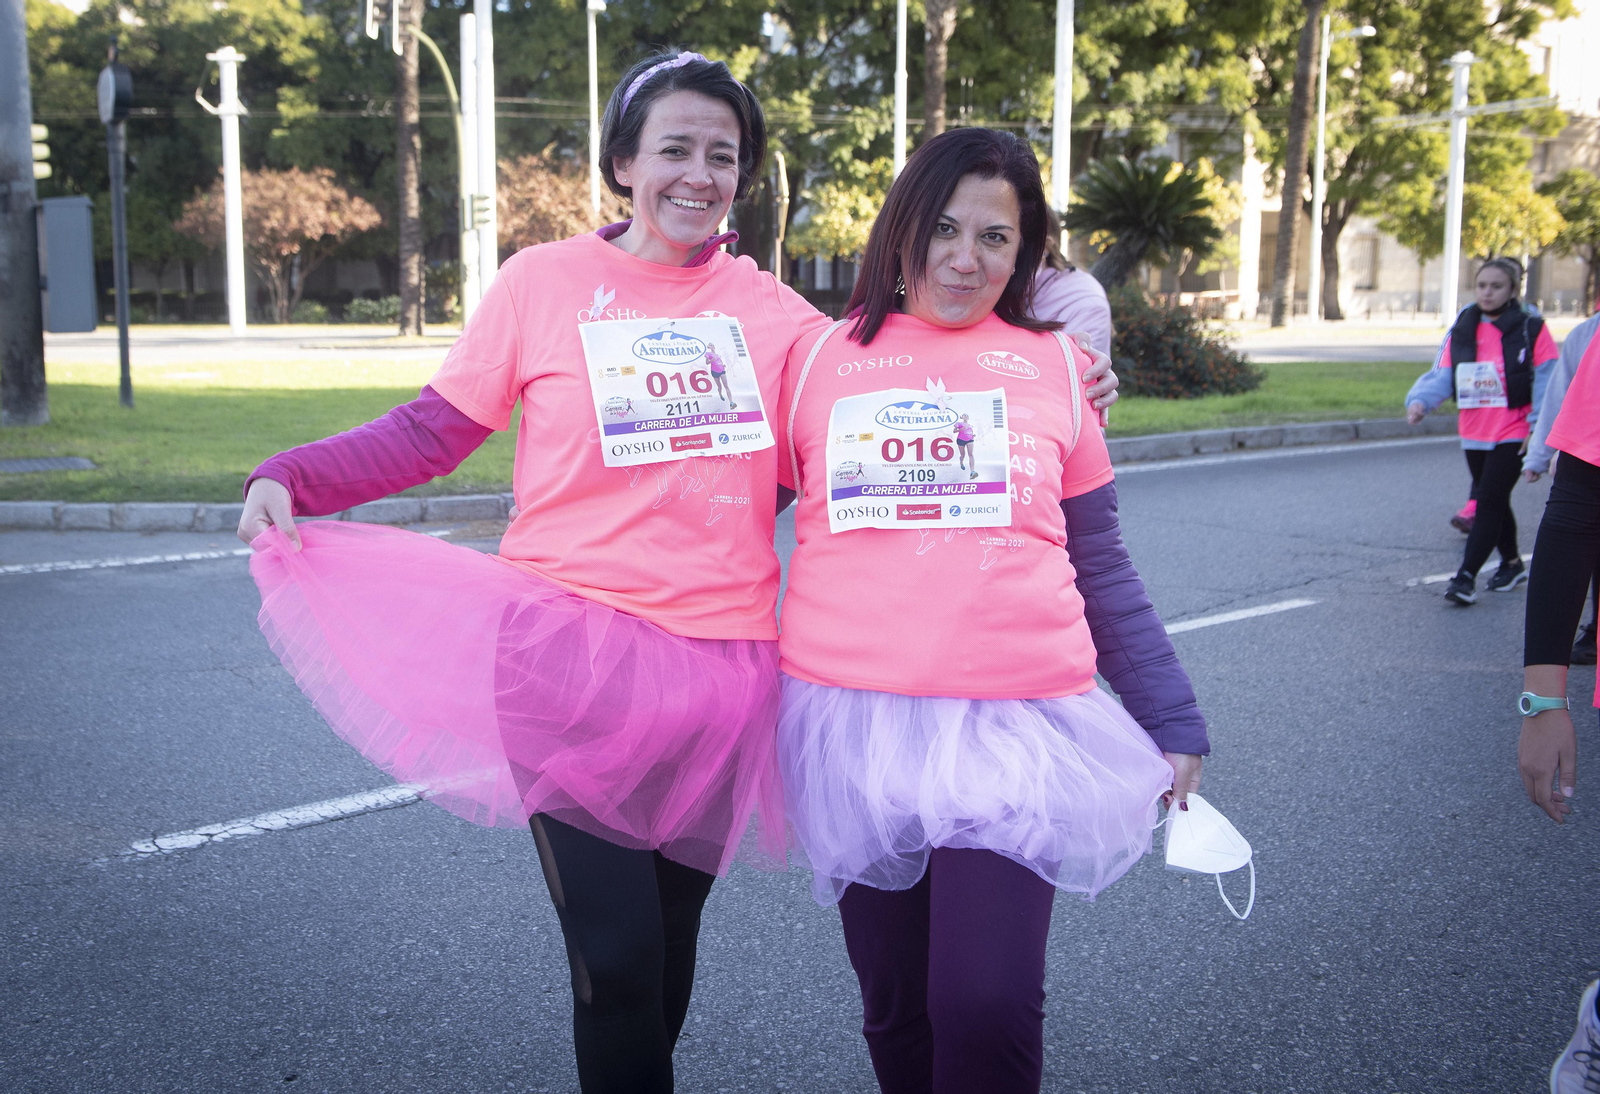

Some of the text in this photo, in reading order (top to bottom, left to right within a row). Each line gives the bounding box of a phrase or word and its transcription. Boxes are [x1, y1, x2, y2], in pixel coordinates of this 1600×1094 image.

[577, 308, 647, 323] OSHO
[639, 343, 702, 356] ASTURIANA
[837, 355, 913, 376] OYSHO
[982, 355, 1036, 377] ASTURIANA
[646, 370, 713, 398] 016
[665, 400, 700, 416] 2111
[635, 413, 738, 431] CARRERA DE LA MUJER
[881, 410, 952, 424] ASTURIANA
[681, 438, 707, 446] Santander
[732, 432, 761, 442] ZURICH
[611, 440, 665, 457] OYSHO
[881, 437, 954, 463] 016
[898, 469, 936, 483] 2109
[861, 484, 977, 496] CARRERA DE LA MUJER
[734, 496, 750, 505] 2021
[837, 505, 889, 521] OYSHO
[965, 506, 998, 514] ZURICH
[1008, 539, 1025, 548] 2021
